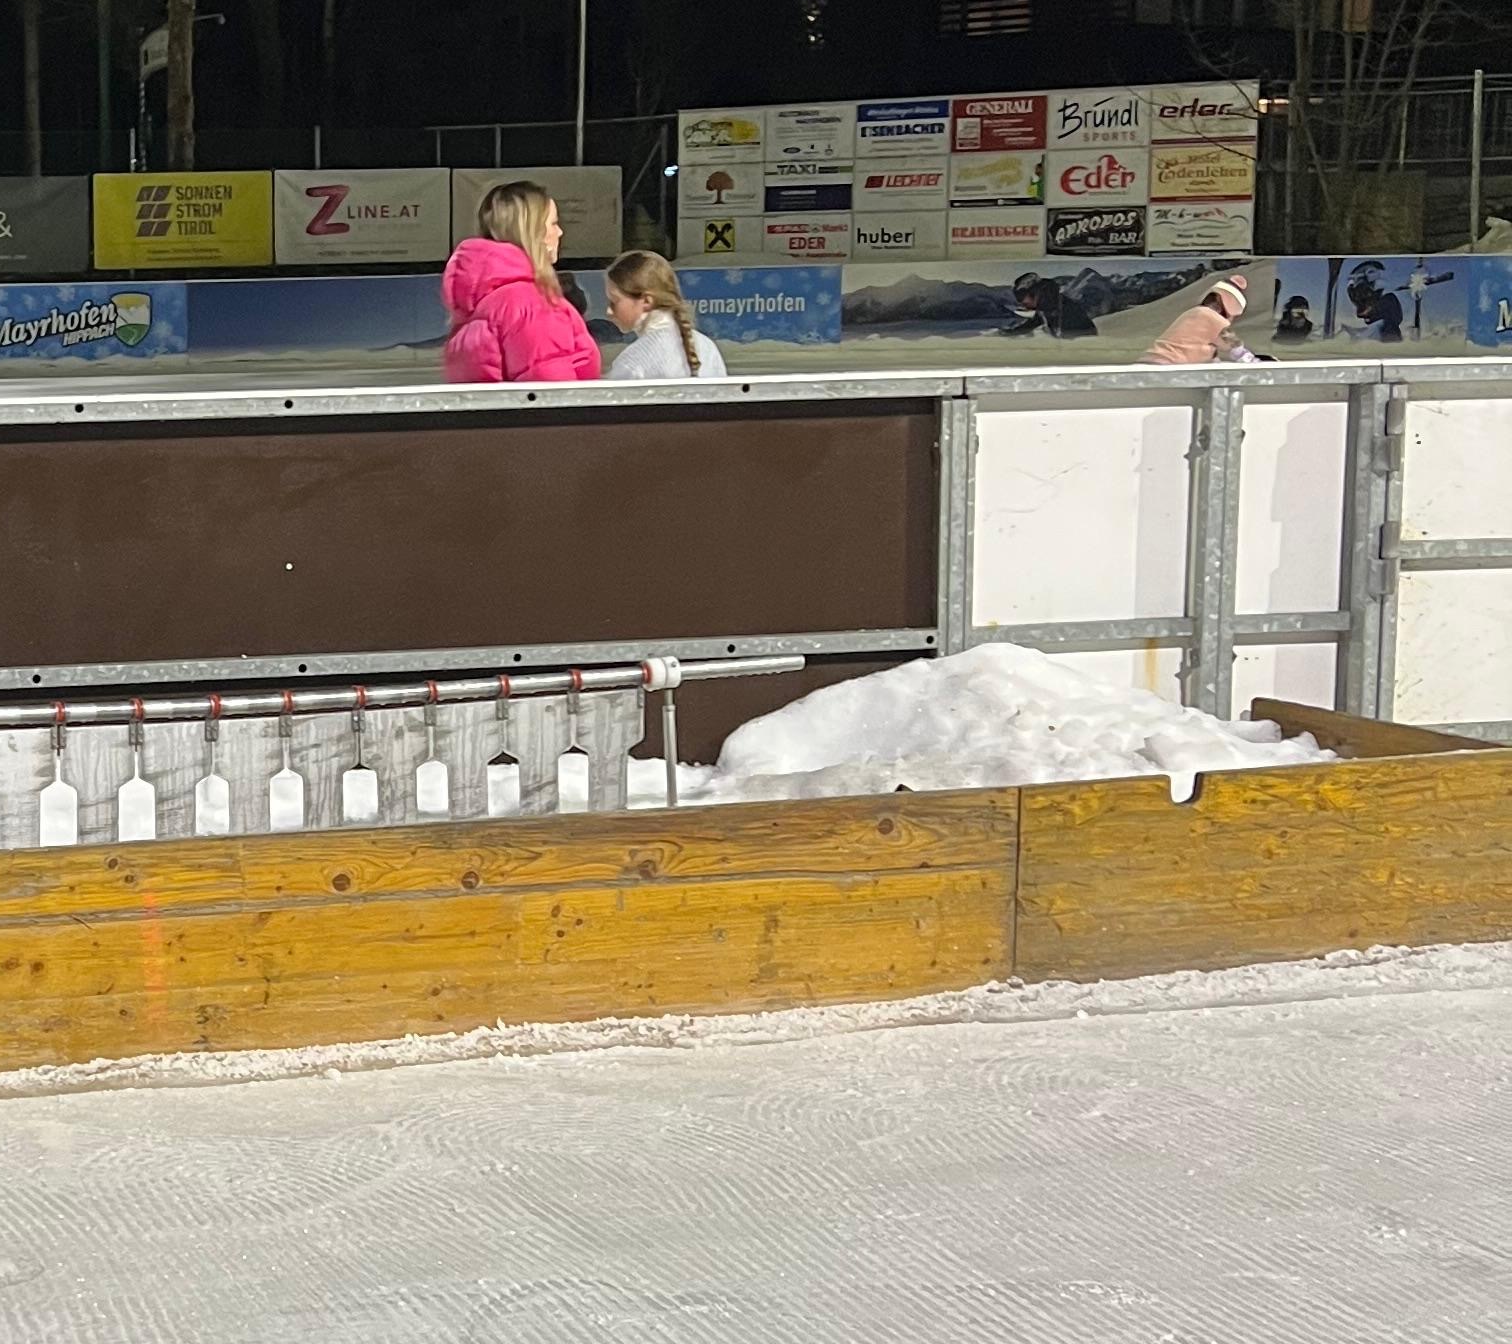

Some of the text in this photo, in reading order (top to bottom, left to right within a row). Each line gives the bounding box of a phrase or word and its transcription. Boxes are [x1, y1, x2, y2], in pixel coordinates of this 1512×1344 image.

[1082, 130, 1137, 142] SPORTS
[777, 164, 816, 175] TAXI
[176, 185, 232, 200] SONNEN
[176, 203, 223, 218] STROM
[347, 205, 422, 219] LINE.AT
[177, 221, 217, 235] TIROL
[857, 227, 912, 243] huber
[789, 236, 825, 250] EDER
[1109, 232, 1137, 244] BAR
[63, 323, 116, 347] HIPPACH
